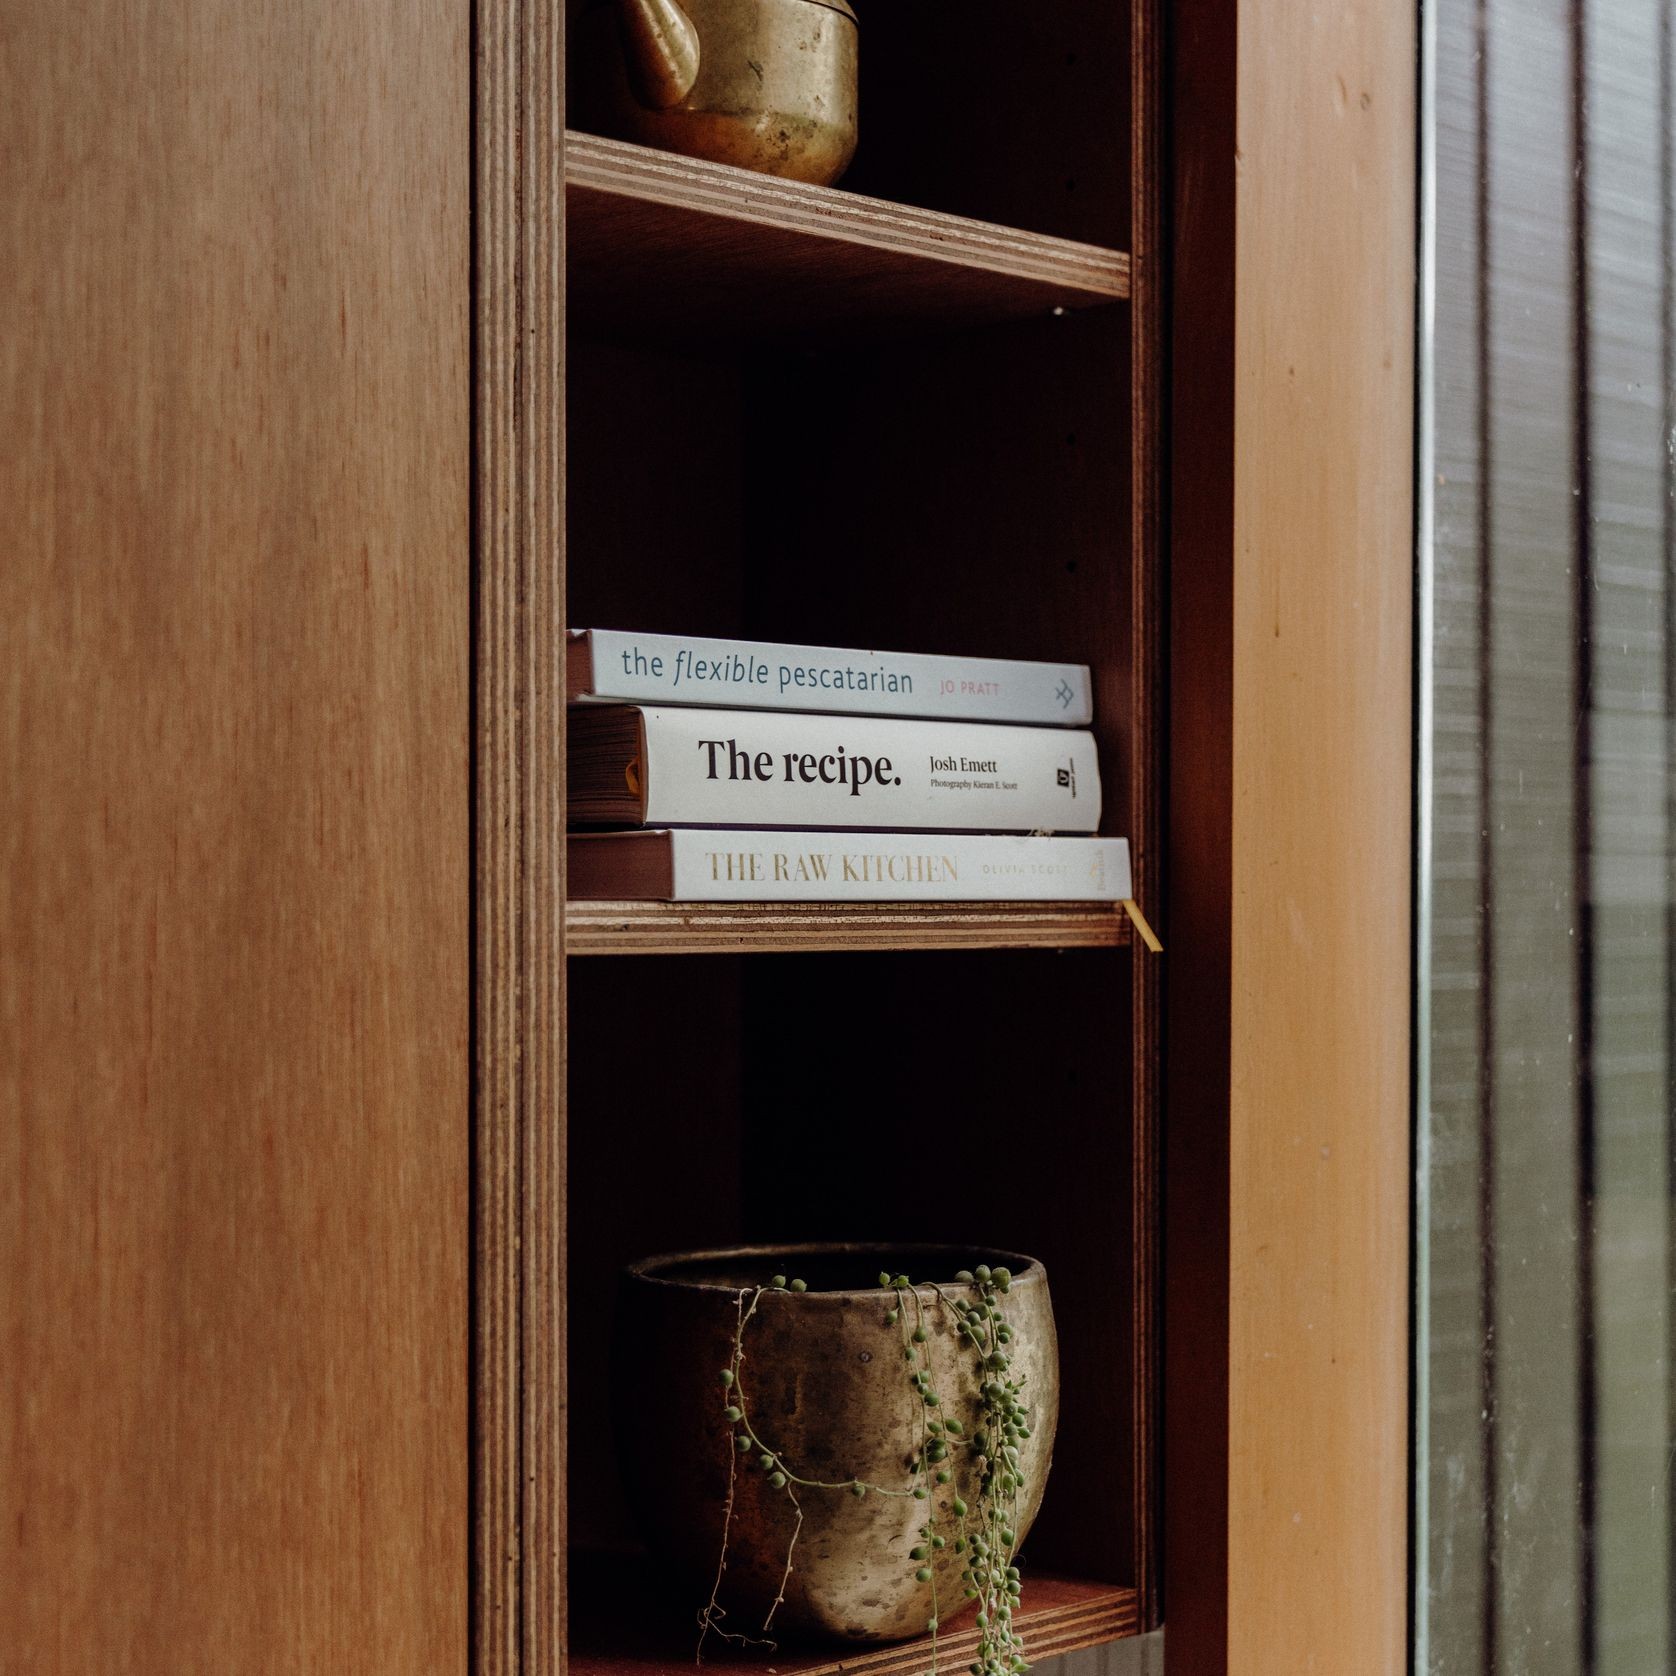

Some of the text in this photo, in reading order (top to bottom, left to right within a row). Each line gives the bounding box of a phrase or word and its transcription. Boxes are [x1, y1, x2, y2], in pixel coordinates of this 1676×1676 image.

[622, 647, 913, 694] the flexible pescatarian
[940, 679, 1000, 696] JO PRATT
[698, 739, 902, 796] The recipe.
[930, 756, 998, 773] Josh Emett
[930, 779, 972, 790] Photography
[973, 780, 995, 790] Kieran
[1002, 782, 1018, 790] Scott
[705, 853, 958, 882] THE RAW KITCHEN
[982, 864, 1025, 874] OLIVIA
